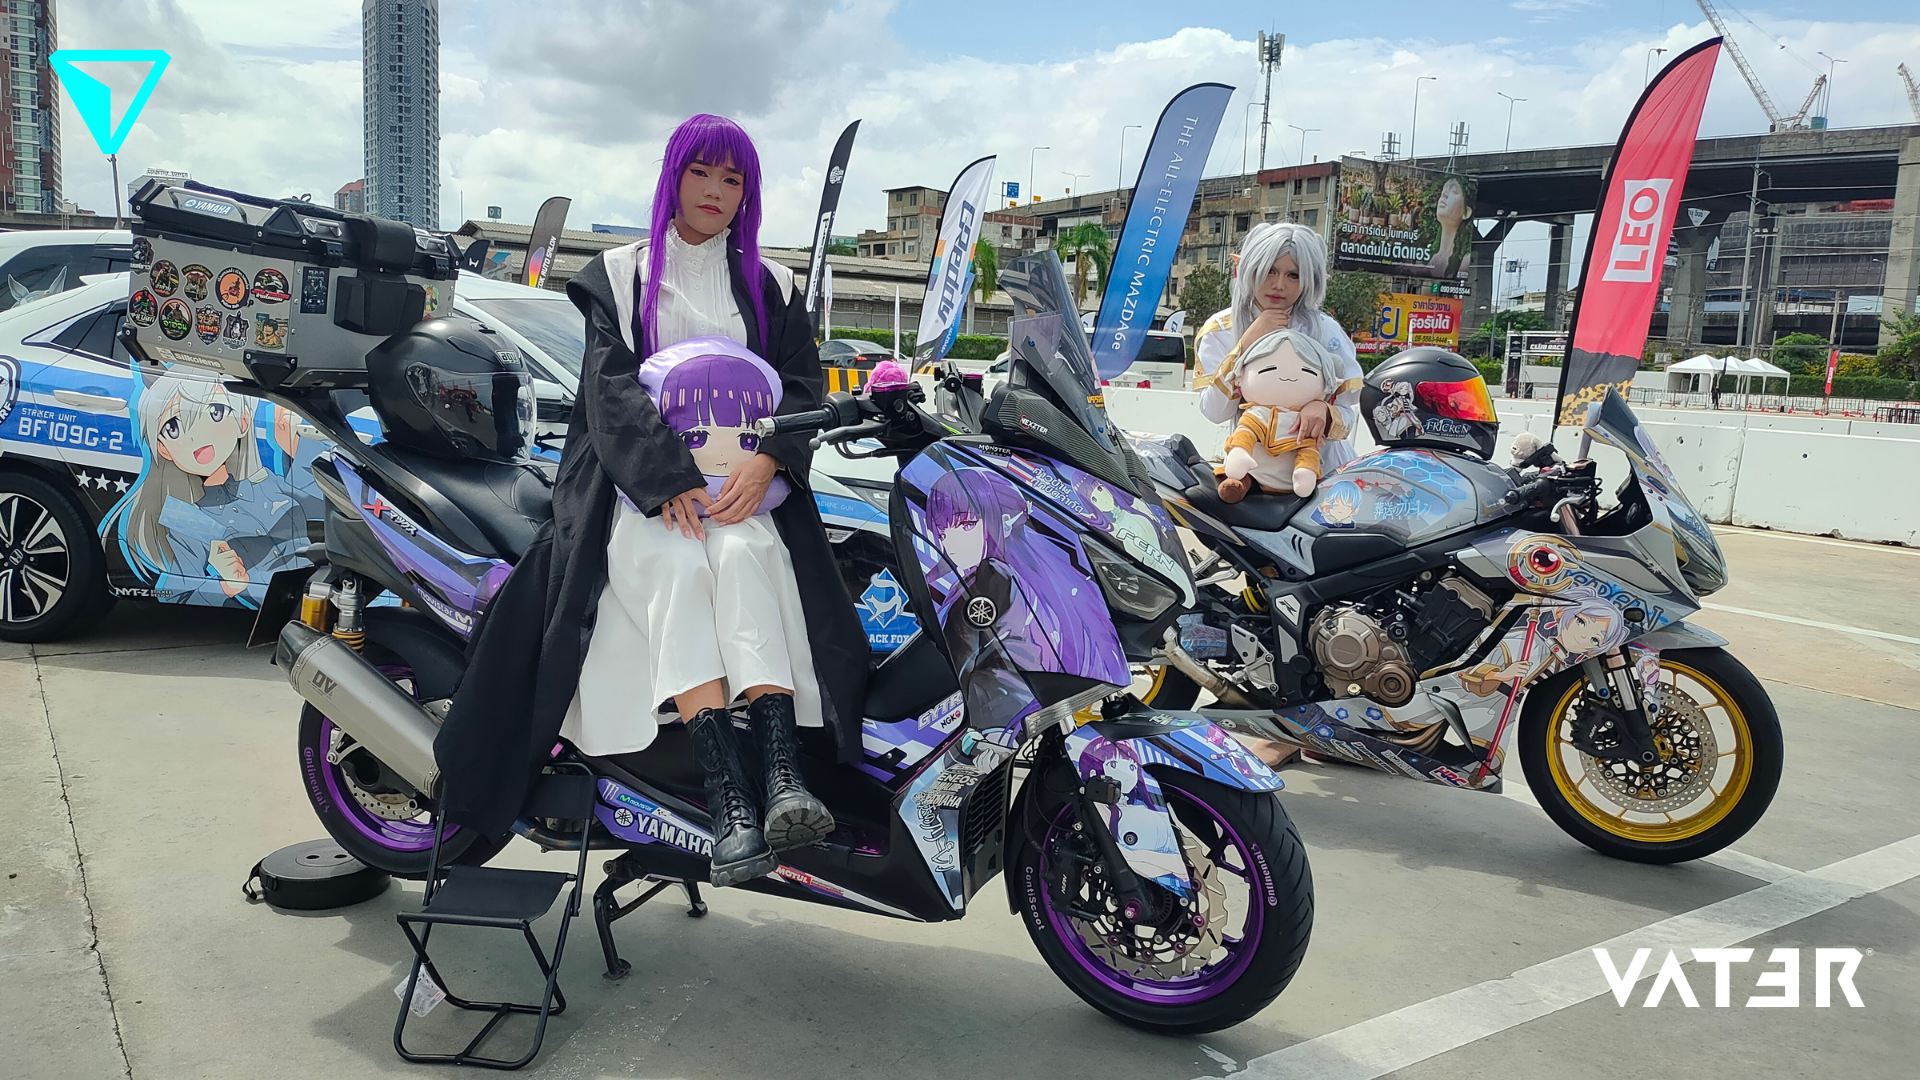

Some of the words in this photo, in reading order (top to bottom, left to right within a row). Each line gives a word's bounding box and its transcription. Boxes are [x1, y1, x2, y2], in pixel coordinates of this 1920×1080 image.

[1176, 116, 1199, 148] THE
[194, 200, 232, 215] YAMAHA
[1137, 151, 1184, 267] ALL-ELECTRIC
[1614, 186, 1660, 271] LEO
[541, 257, 551, 277] AUTO
[546, 236, 557, 259] SALON
[1340, 241, 1392, 257] ตลาดต้นไม้
[1392, 242, 1432, 261] ติดแอร์
[1111, 270, 1146, 351] MAZDA6e
[22, 408, 55, 419] STRIKER
[59, 413, 77, 422] UNIT
[18, 417, 124, 451] BF109G-2
[979, 444, 1011, 455] MONSTER
[1116, 528, 1175, 572] FERN
[114, 587, 149, 597] NYT-Z
[869, 634, 888, 644] ACK
[940, 713, 958, 729] NGK
[304, 747, 327, 806] Continental
[938, 771, 979, 786] ENEOS
[629, 799, 654, 812] movistar
[637, 812, 713, 858] YAMAHA
[776, 867, 809, 884] MOTUL
[1253, 850, 1278, 906] Continental
[1025, 866, 1045, 931] ContiScoot
